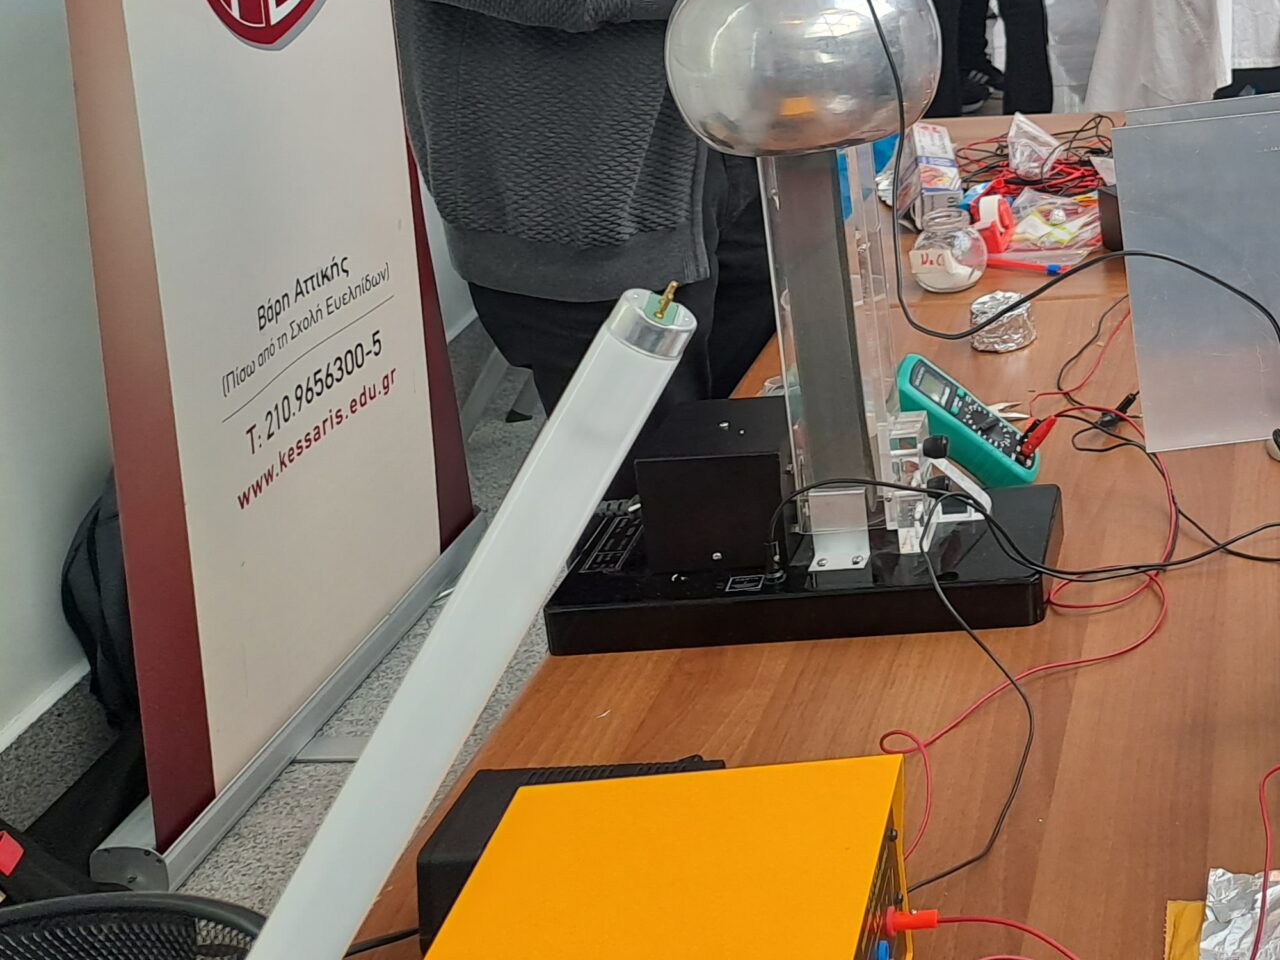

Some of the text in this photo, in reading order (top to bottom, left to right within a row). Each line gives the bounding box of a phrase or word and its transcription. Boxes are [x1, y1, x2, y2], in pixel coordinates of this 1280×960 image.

[222, 262, 390, 398] (Πίσω από τη Σχολή Ευελπίδων)
[257, 256, 350, 331] Βάρη Αττικής
[237, 368, 396, 510] www.kessaris.edu.gr
[265, 330, 383, 441] 210.9656300-5
